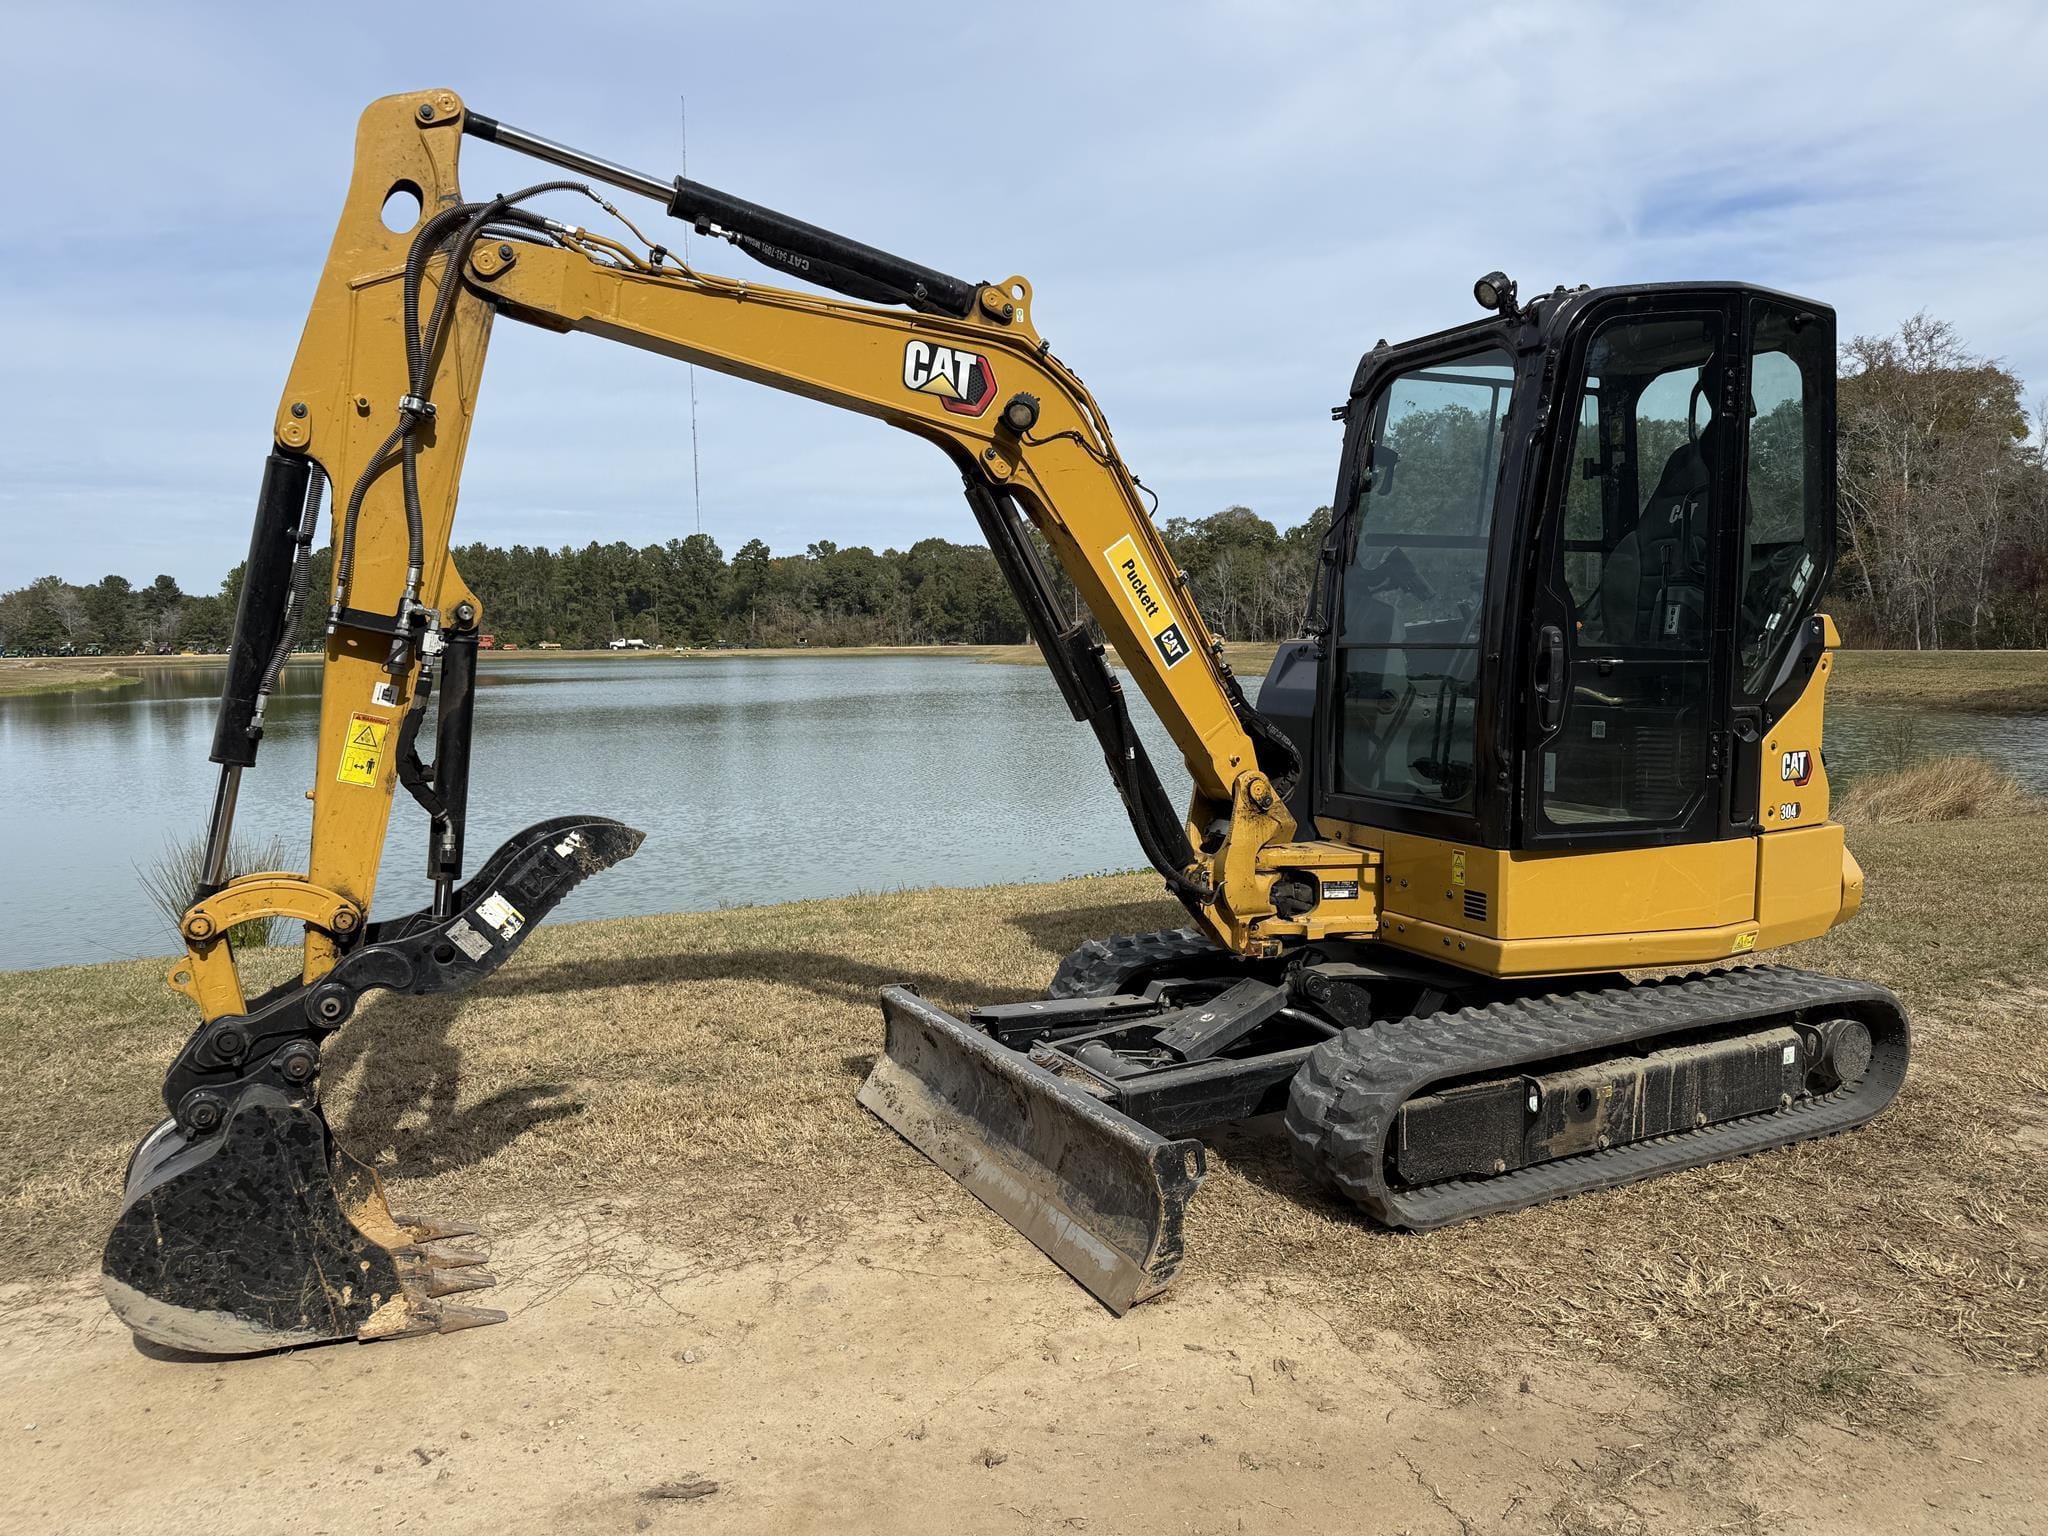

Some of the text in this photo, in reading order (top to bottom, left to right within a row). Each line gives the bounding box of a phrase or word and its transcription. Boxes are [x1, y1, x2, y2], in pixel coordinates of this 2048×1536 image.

[787, 254, 810, 271] CAT
[903, 339, 978, 400] CAT
[1121, 558, 1184, 657] Puckett CAT
[1782, 751, 1807, 780] CAT
[1780, 803, 1797, 820] 304
